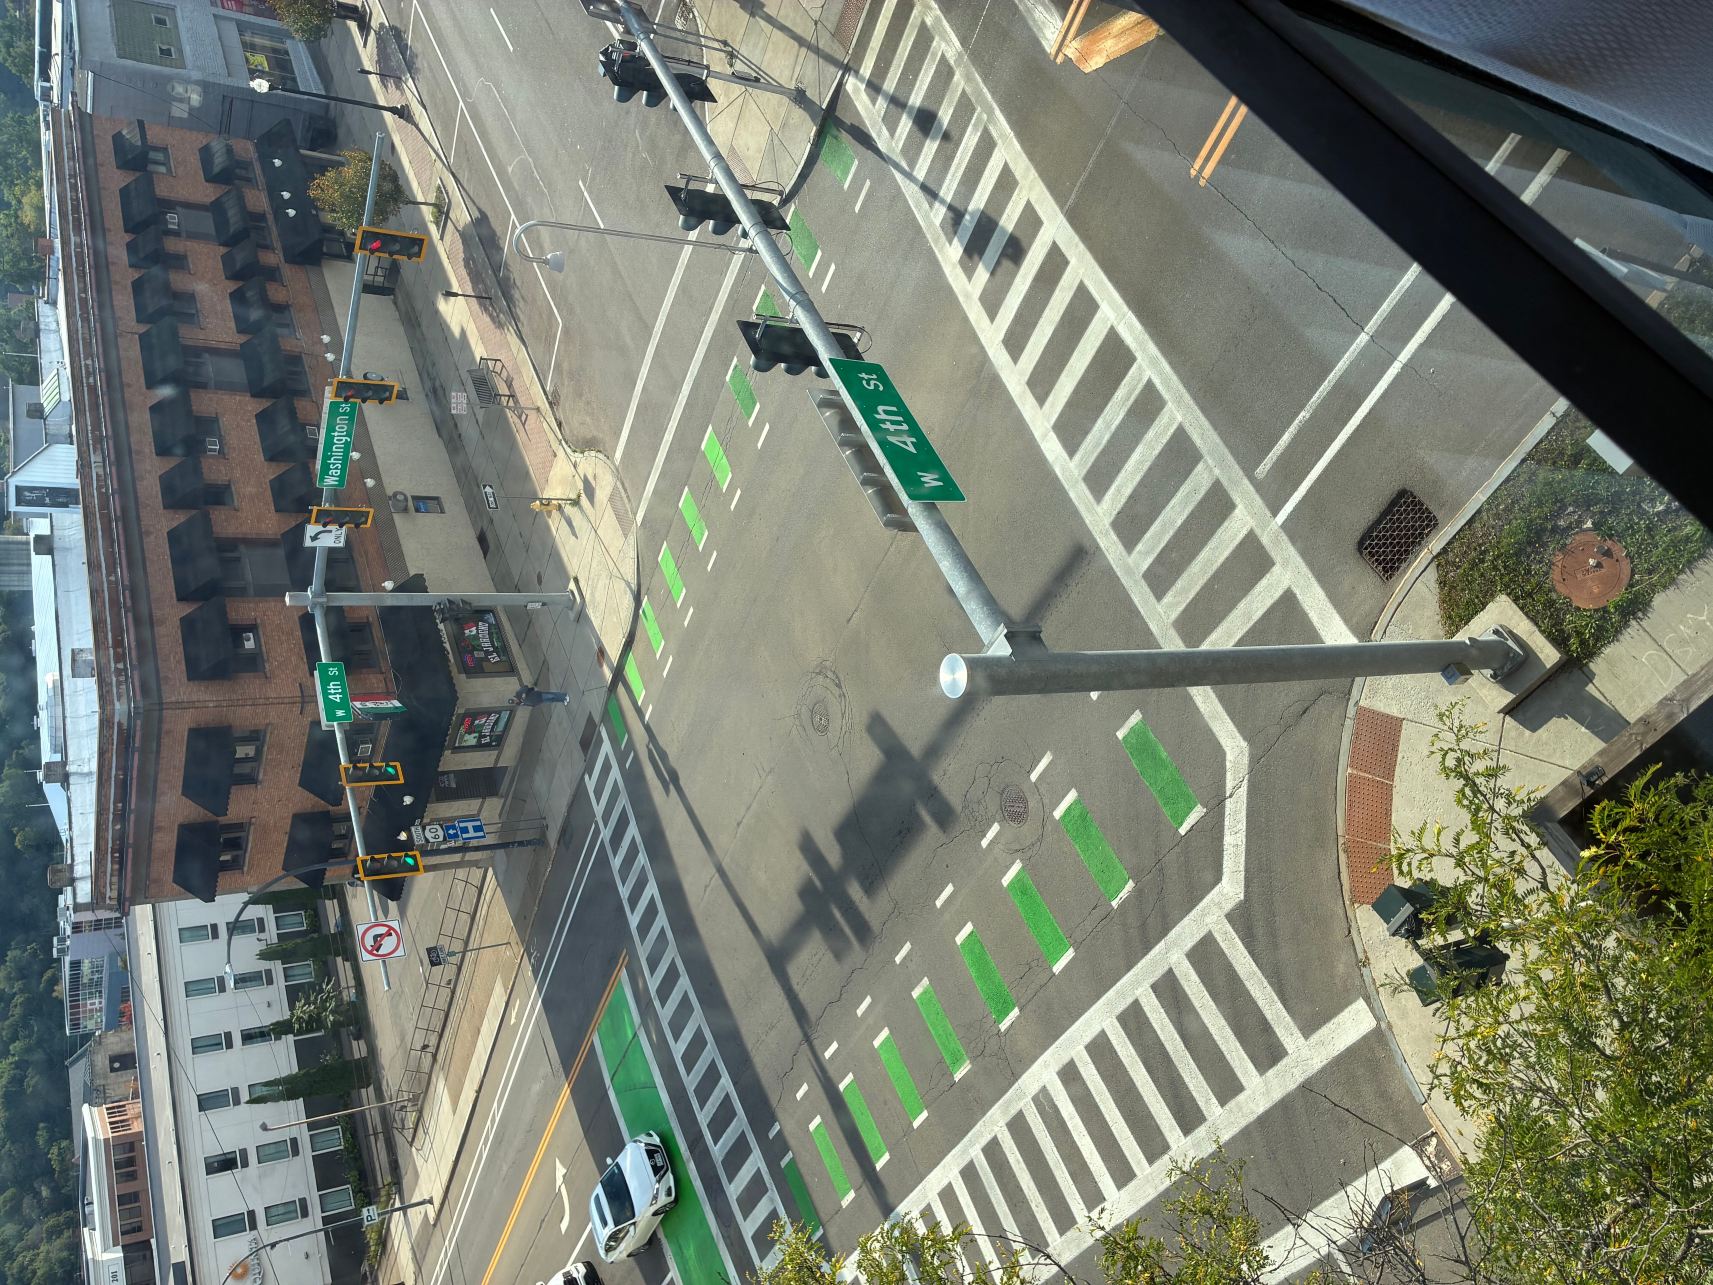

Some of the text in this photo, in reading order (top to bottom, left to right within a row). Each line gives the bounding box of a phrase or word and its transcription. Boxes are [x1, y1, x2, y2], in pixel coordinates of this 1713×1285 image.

[857, 372, 944, 488] W 4th St
[323, 403, 351, 485] Washington St
[333, 527, 343, 545] ONLY
[326, 667, 347, 717] W 4th St
[414, 825, 425, 843] SOUTH
[428, 827, 440, 840] 60
[459, 820, 485, 838] H
[365, 1214, 376, 1222] P
